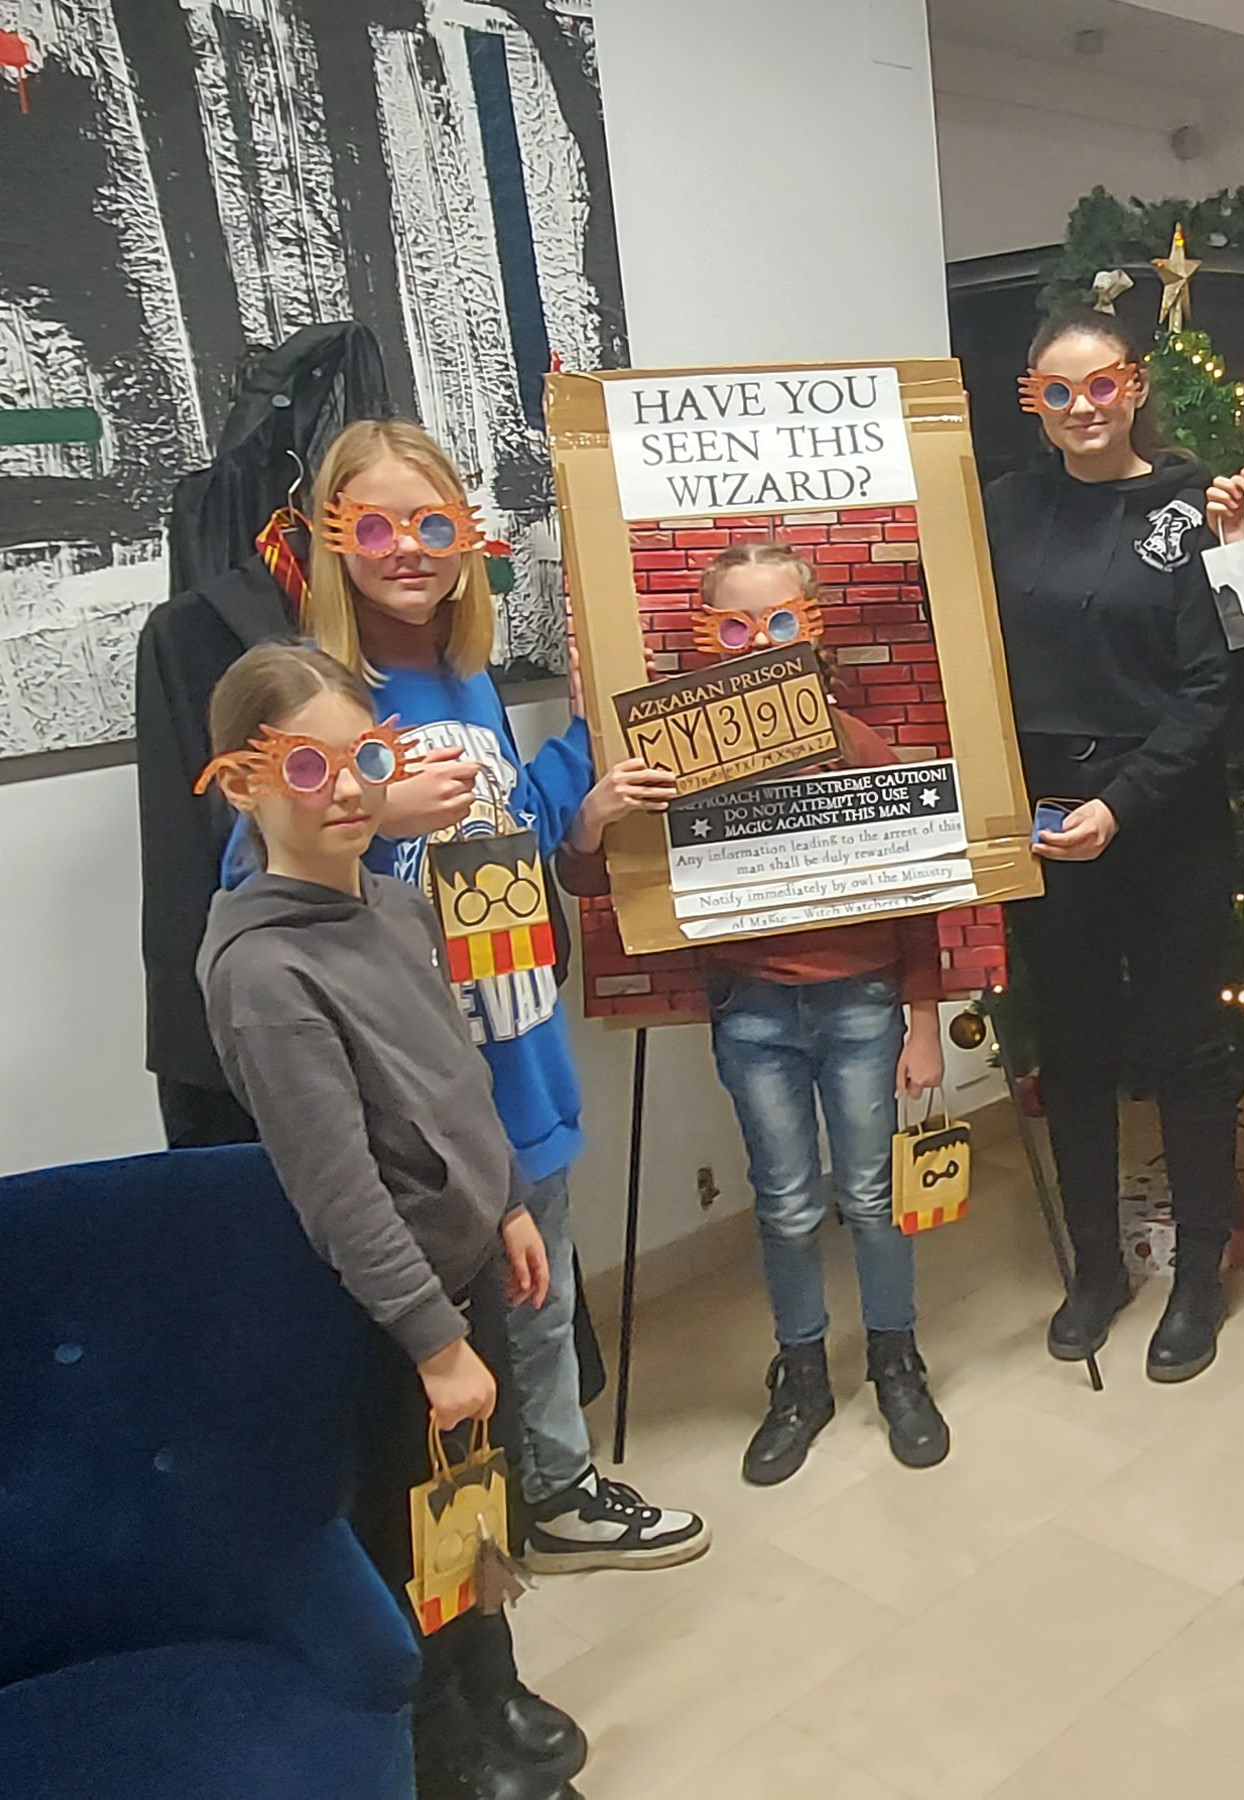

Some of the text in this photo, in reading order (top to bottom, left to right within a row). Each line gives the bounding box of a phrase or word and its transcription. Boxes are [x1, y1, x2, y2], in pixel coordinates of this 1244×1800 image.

[631, 374, 879, 426] HAVE YOU
[641, 421, 885, 467] SEEN THIS
[666, 465, 874, 509] WIZARD?
[628, 657, 803, 722] AZKABAN PRISON
[724, 787, 909, 822] DO NOT ATTEMPT TO USE
[763, 785, 801, 800] WITH
[806, 776, 873, 795] EXTREME
[724, 802, 912, 838] MAGIC AGAINST THIS MAN
[676, 855, 703, 869] Any
[708, 843, 787, 862] information
[842, 835, 855, 846] to
[859, 828, 879, 842] the
[883, 827, 918, 841] arrest
[922, 820, 934, 835] of
[939, 818, 961, 832] this
[737, 842, 910, 875] man shall be duly rewarded
[699, 866, 954, 908] Notify immediately by owl the Ministry
